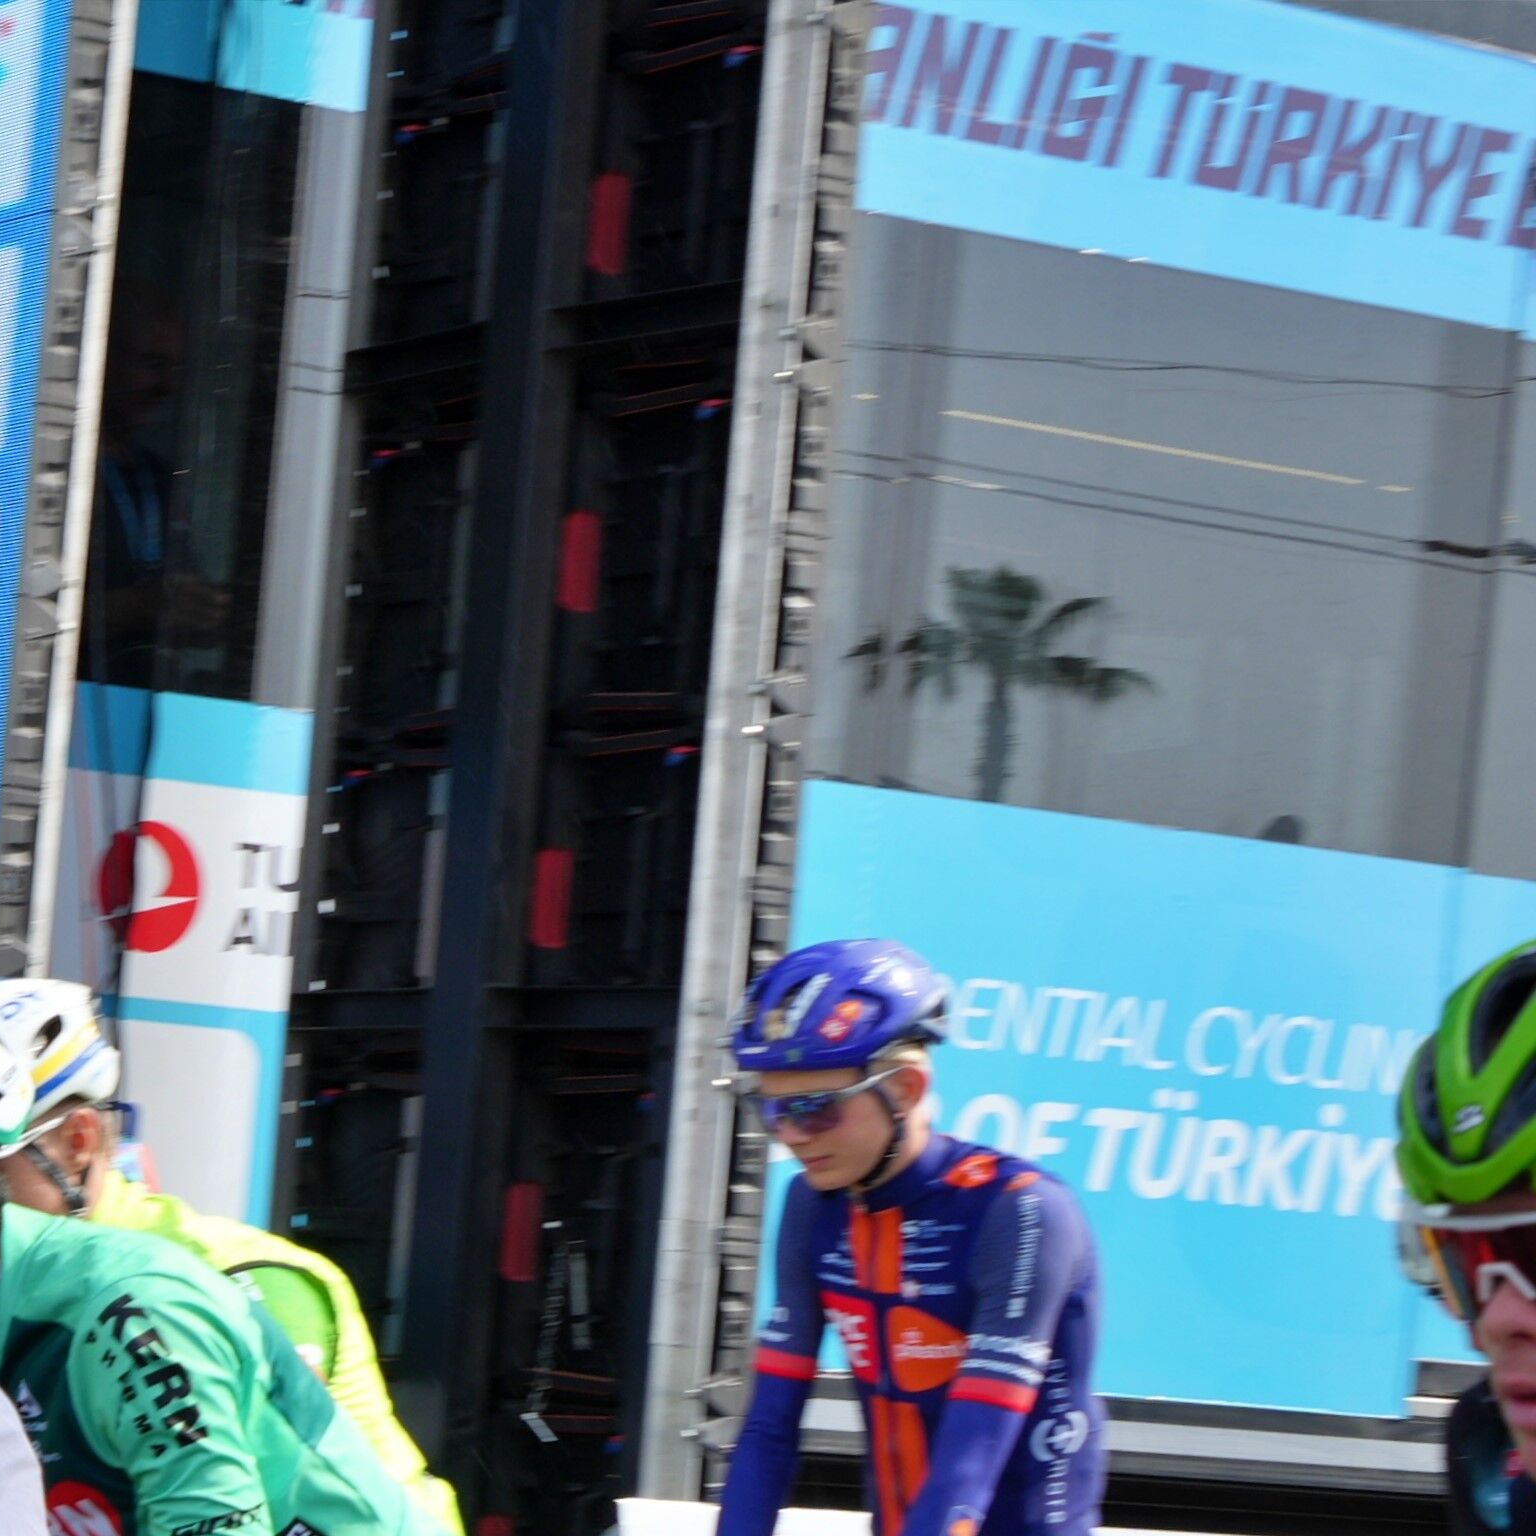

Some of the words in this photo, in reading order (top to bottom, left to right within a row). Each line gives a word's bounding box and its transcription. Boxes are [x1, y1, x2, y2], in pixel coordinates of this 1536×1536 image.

[1153, 62, 1515, 242] TÜRKİYE
[1184, 1006, 1426, 1096] CYCLIN
[97, 1293, 210, 1448] KERN
